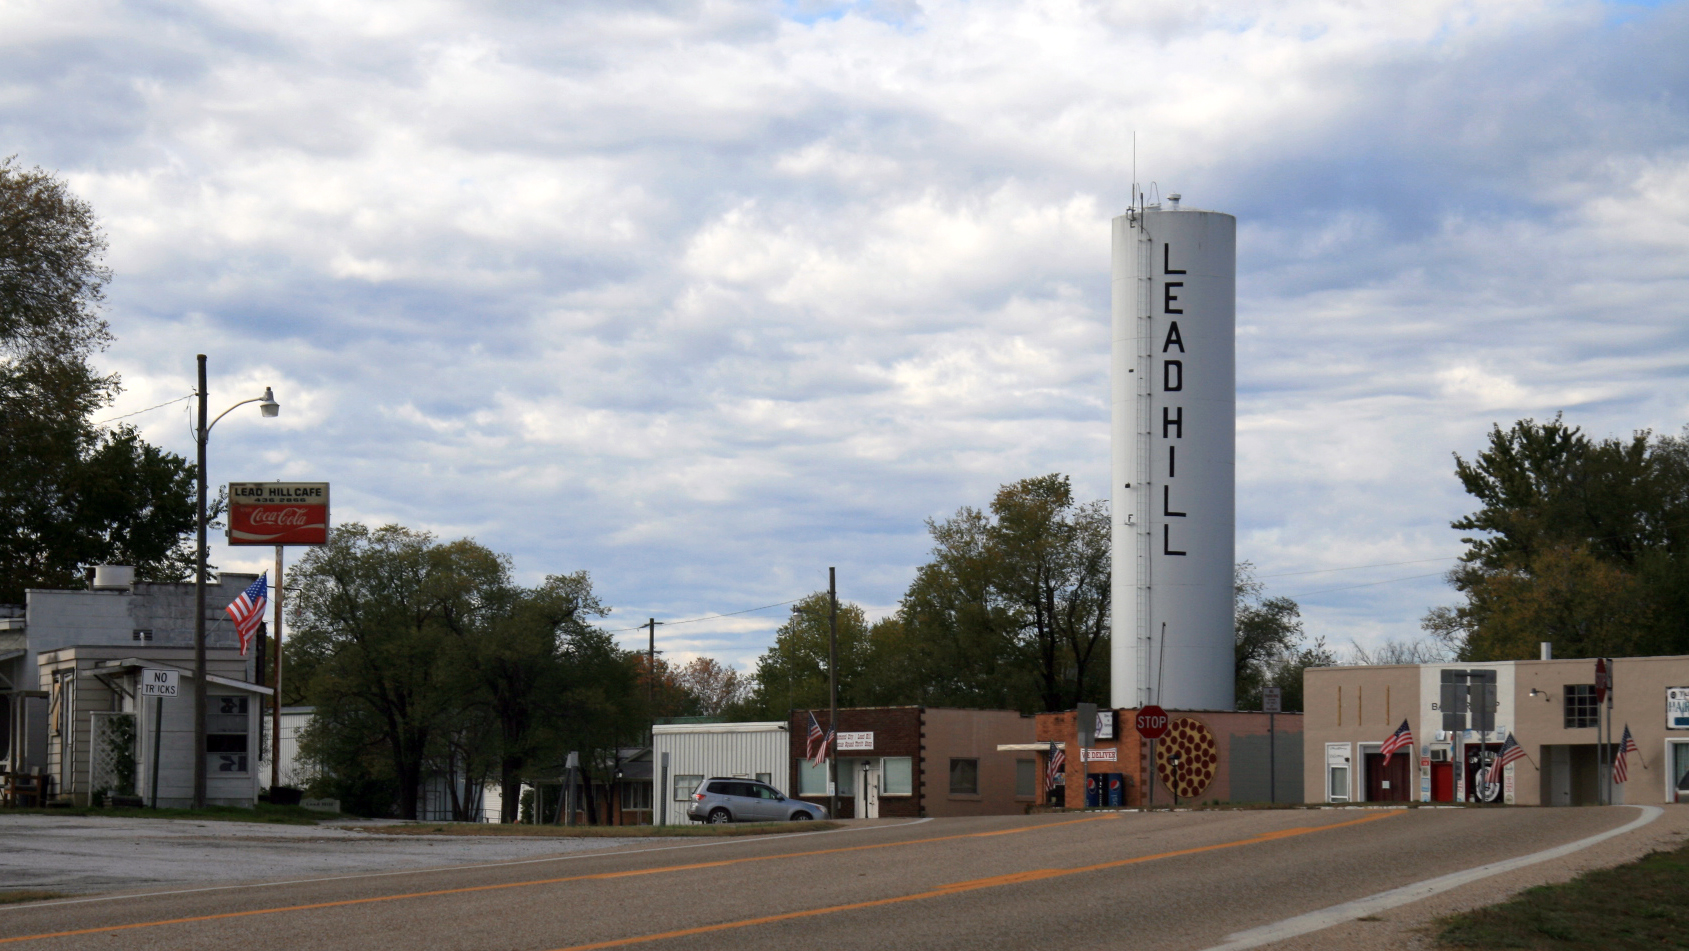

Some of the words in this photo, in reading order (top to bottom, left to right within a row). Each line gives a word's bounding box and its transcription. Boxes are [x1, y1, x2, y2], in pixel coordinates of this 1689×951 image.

[1162, 243, 1187, 391] LEAD
[1163, 407, 1187, 556] HILL
[235, 487, 263, 497] LEAD
[269, 487, 292, 497] HILL
[294, 487, 322, 497] CAFE
[154, 672, 167, 683] NO
[1137, 715, 1167, 729] STOP
[1091, 751, 1116, 759] DELIVER
